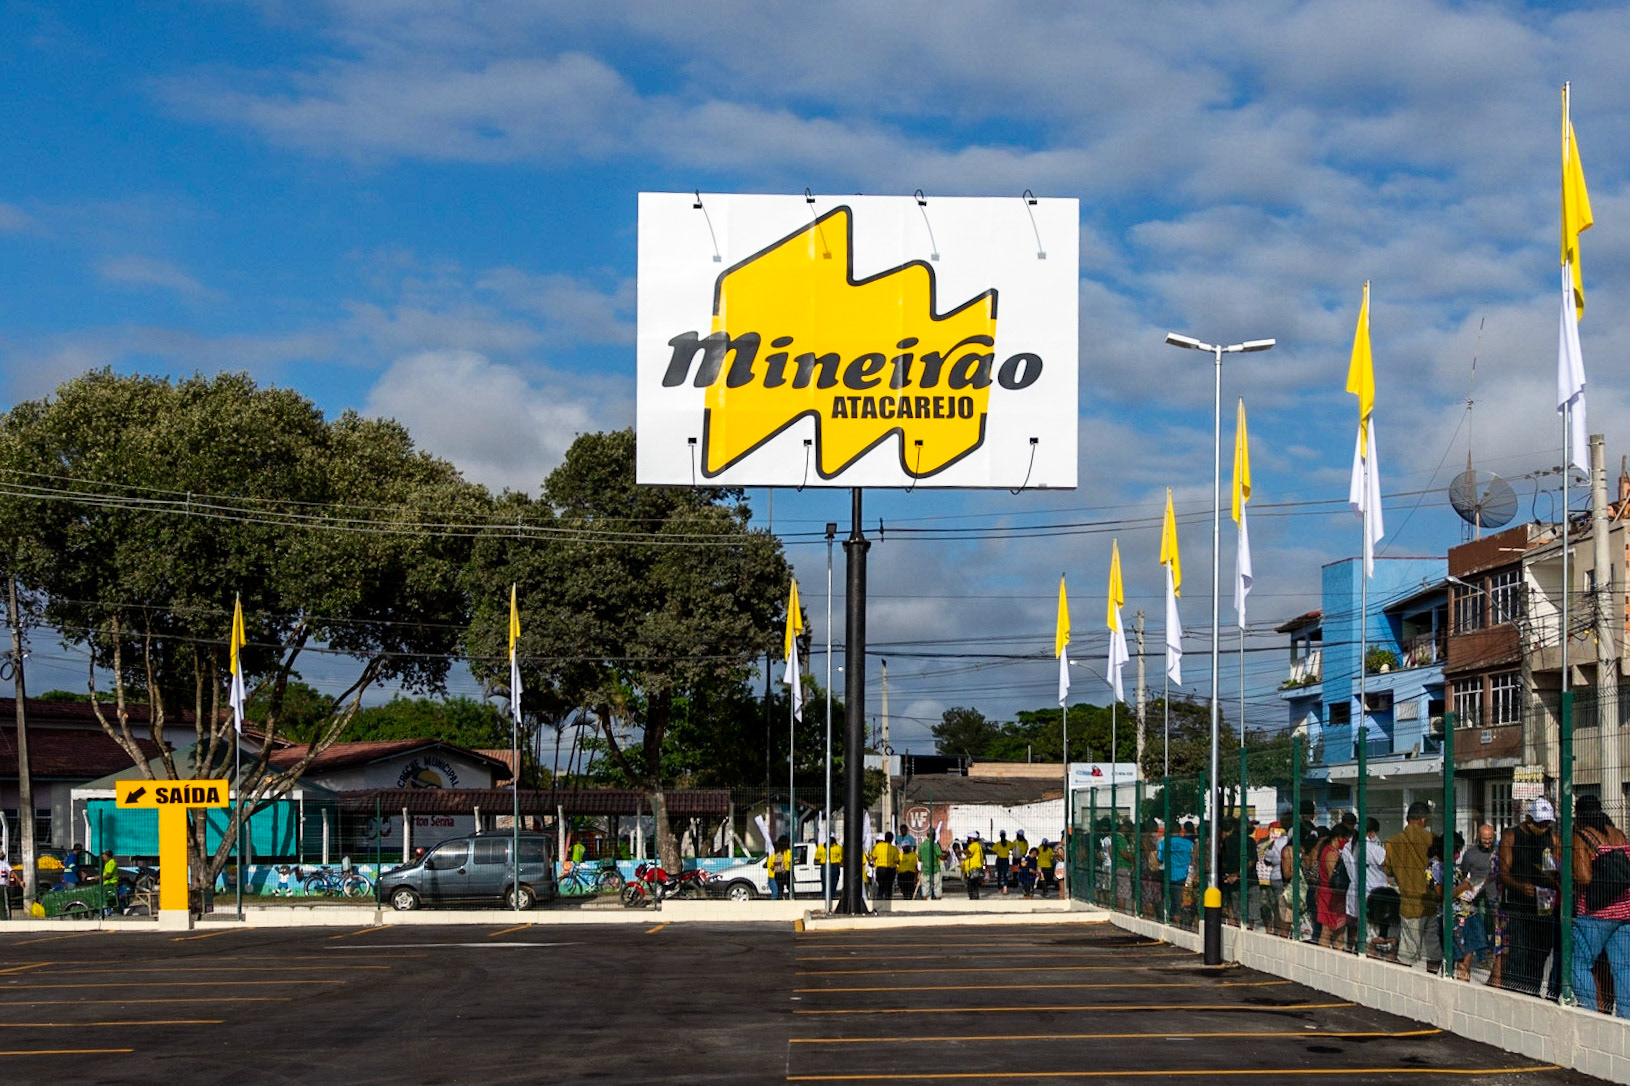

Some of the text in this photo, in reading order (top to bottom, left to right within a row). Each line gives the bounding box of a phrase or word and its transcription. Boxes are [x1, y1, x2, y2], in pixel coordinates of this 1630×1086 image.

[831, 396, 974, 420] ATACAREJO
[423, 755, 460, 788] MUNICIPAL
[155, 784, 220, 804] SAÍDA
[431, 815, 454, 827] Senna
[910, 811, 928, 828] WF
